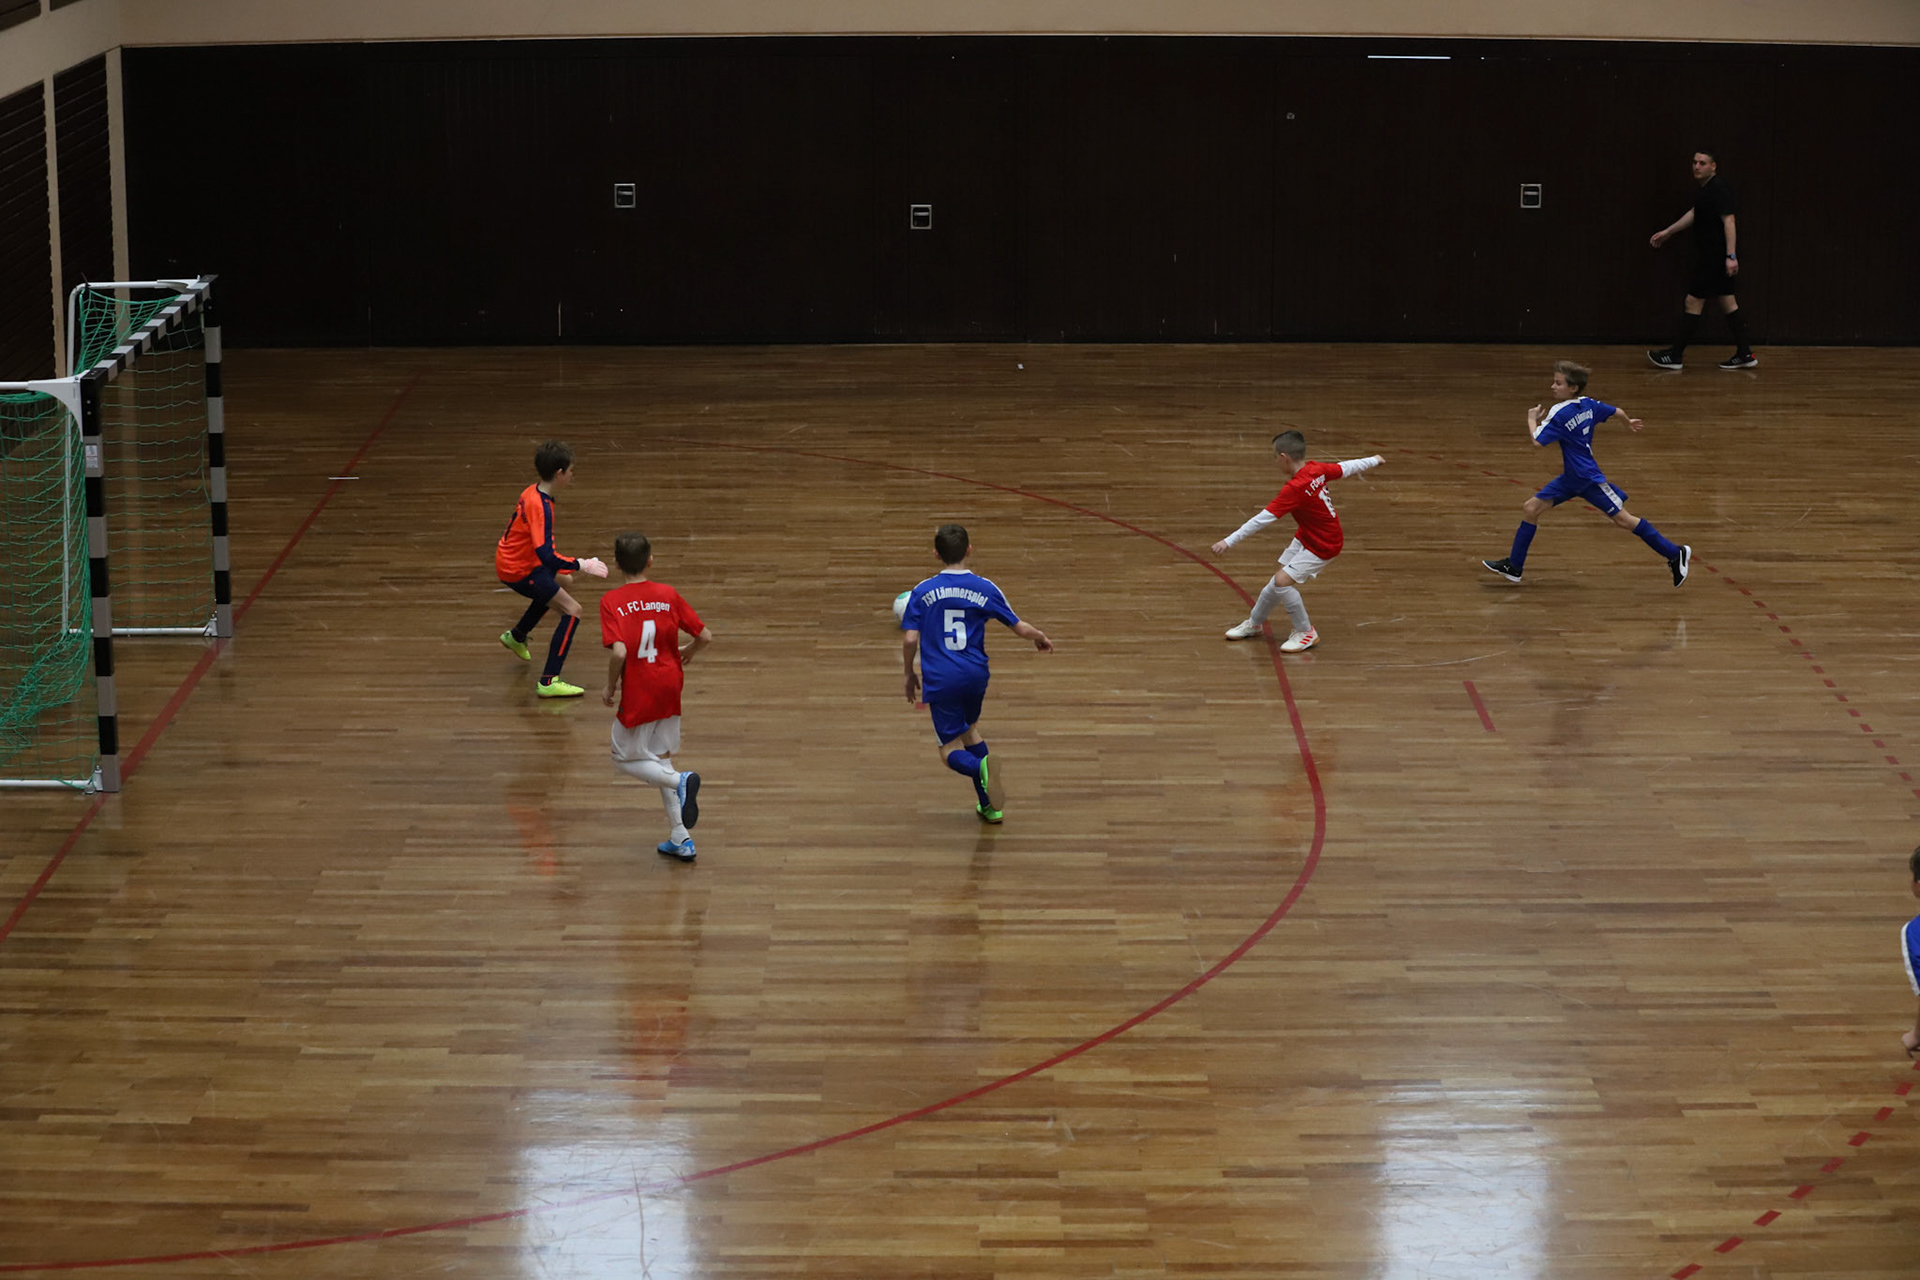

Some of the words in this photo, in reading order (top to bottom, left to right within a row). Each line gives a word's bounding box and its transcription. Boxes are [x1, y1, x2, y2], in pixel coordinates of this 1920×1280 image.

[617, 607, 628, 617] 1.
[627, 601, 640, 613] FC
[640, 600, 670, 612] Langen
[921, 590, 937, 607] TSV
[936, 586, 989, 608] Lämmerspiel
[637, 620, 658, 663] 4
[944, 609, 967, 651] 5
